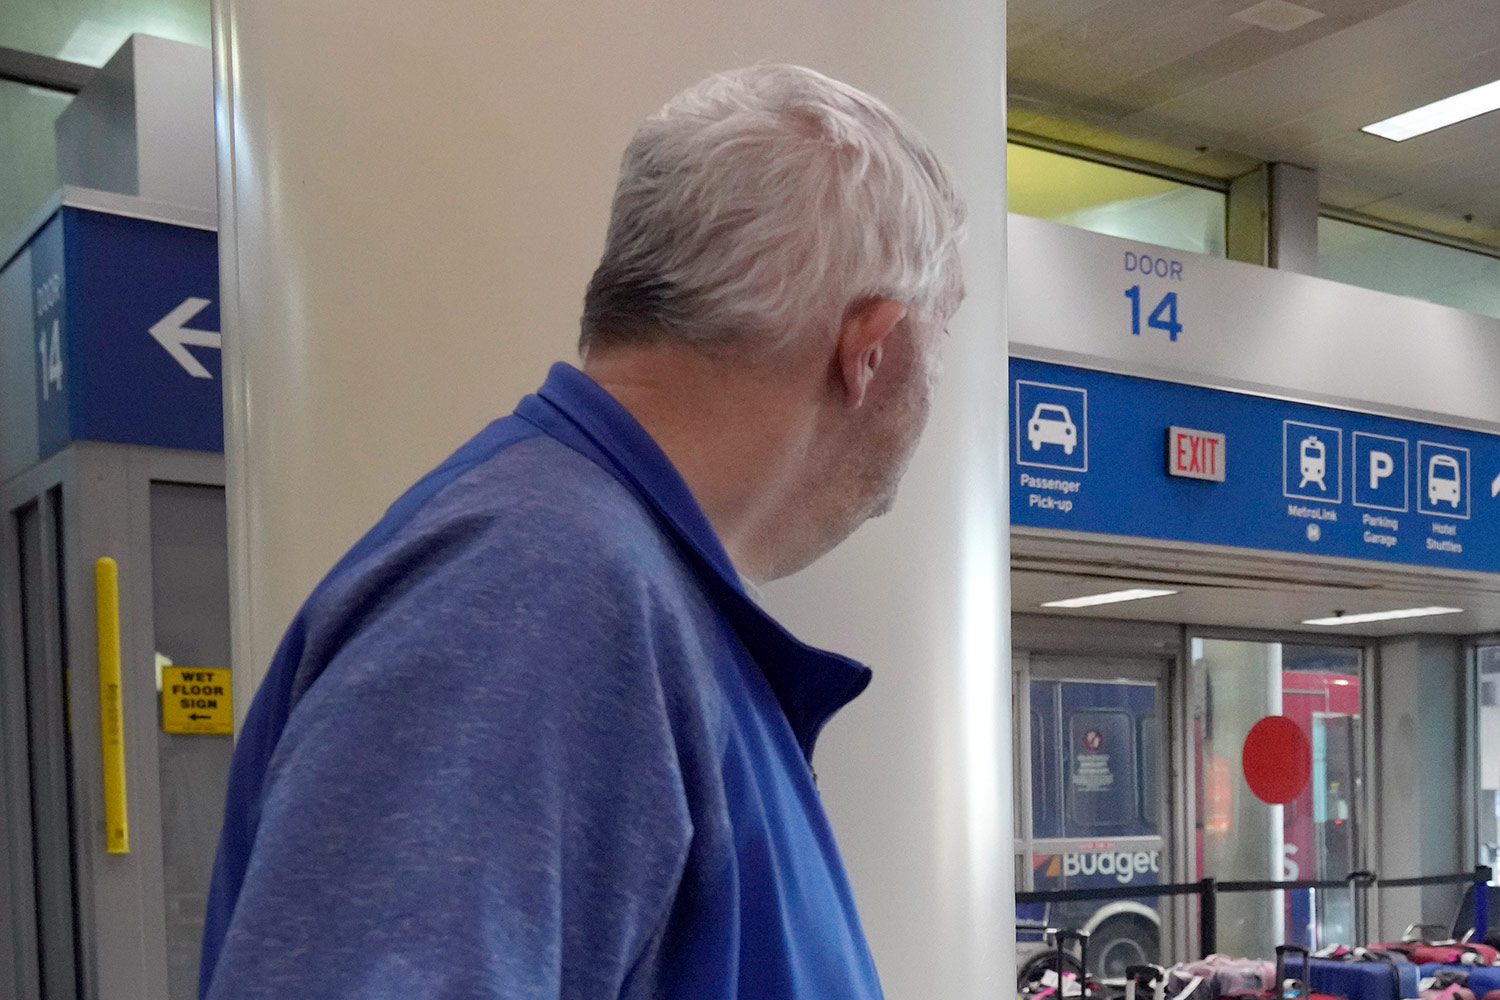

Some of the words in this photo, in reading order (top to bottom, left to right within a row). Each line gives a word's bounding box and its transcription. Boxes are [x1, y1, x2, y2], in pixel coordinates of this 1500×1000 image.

[1124, 251, 1183, 281] DOOR
[1124, 285, 1183, 342] 14
[38, 318, 63, 401] 14
[1176, 433, 1219, 475] EXIT
[1369, 450, 1394, 490] P
[1020, 473, 1081, 494] Passenger
[1028, 494, 1073, 513] Pick-up
[1287, 504, 1338, 522] MetroLink
[1362, 513, 1399, 531] Parking
[1431, 522, 1458, 536] Hotel
[1363, 530, 1398, 548] Garage
[1425, 538, 1463, 553] Shuttles
[180, 671, 215, 683] WET
[171, 685, 224, 697] FLOOR
[179, 698, 218, 710] SIGN
[1062, 851, 1160, 884] Budget
